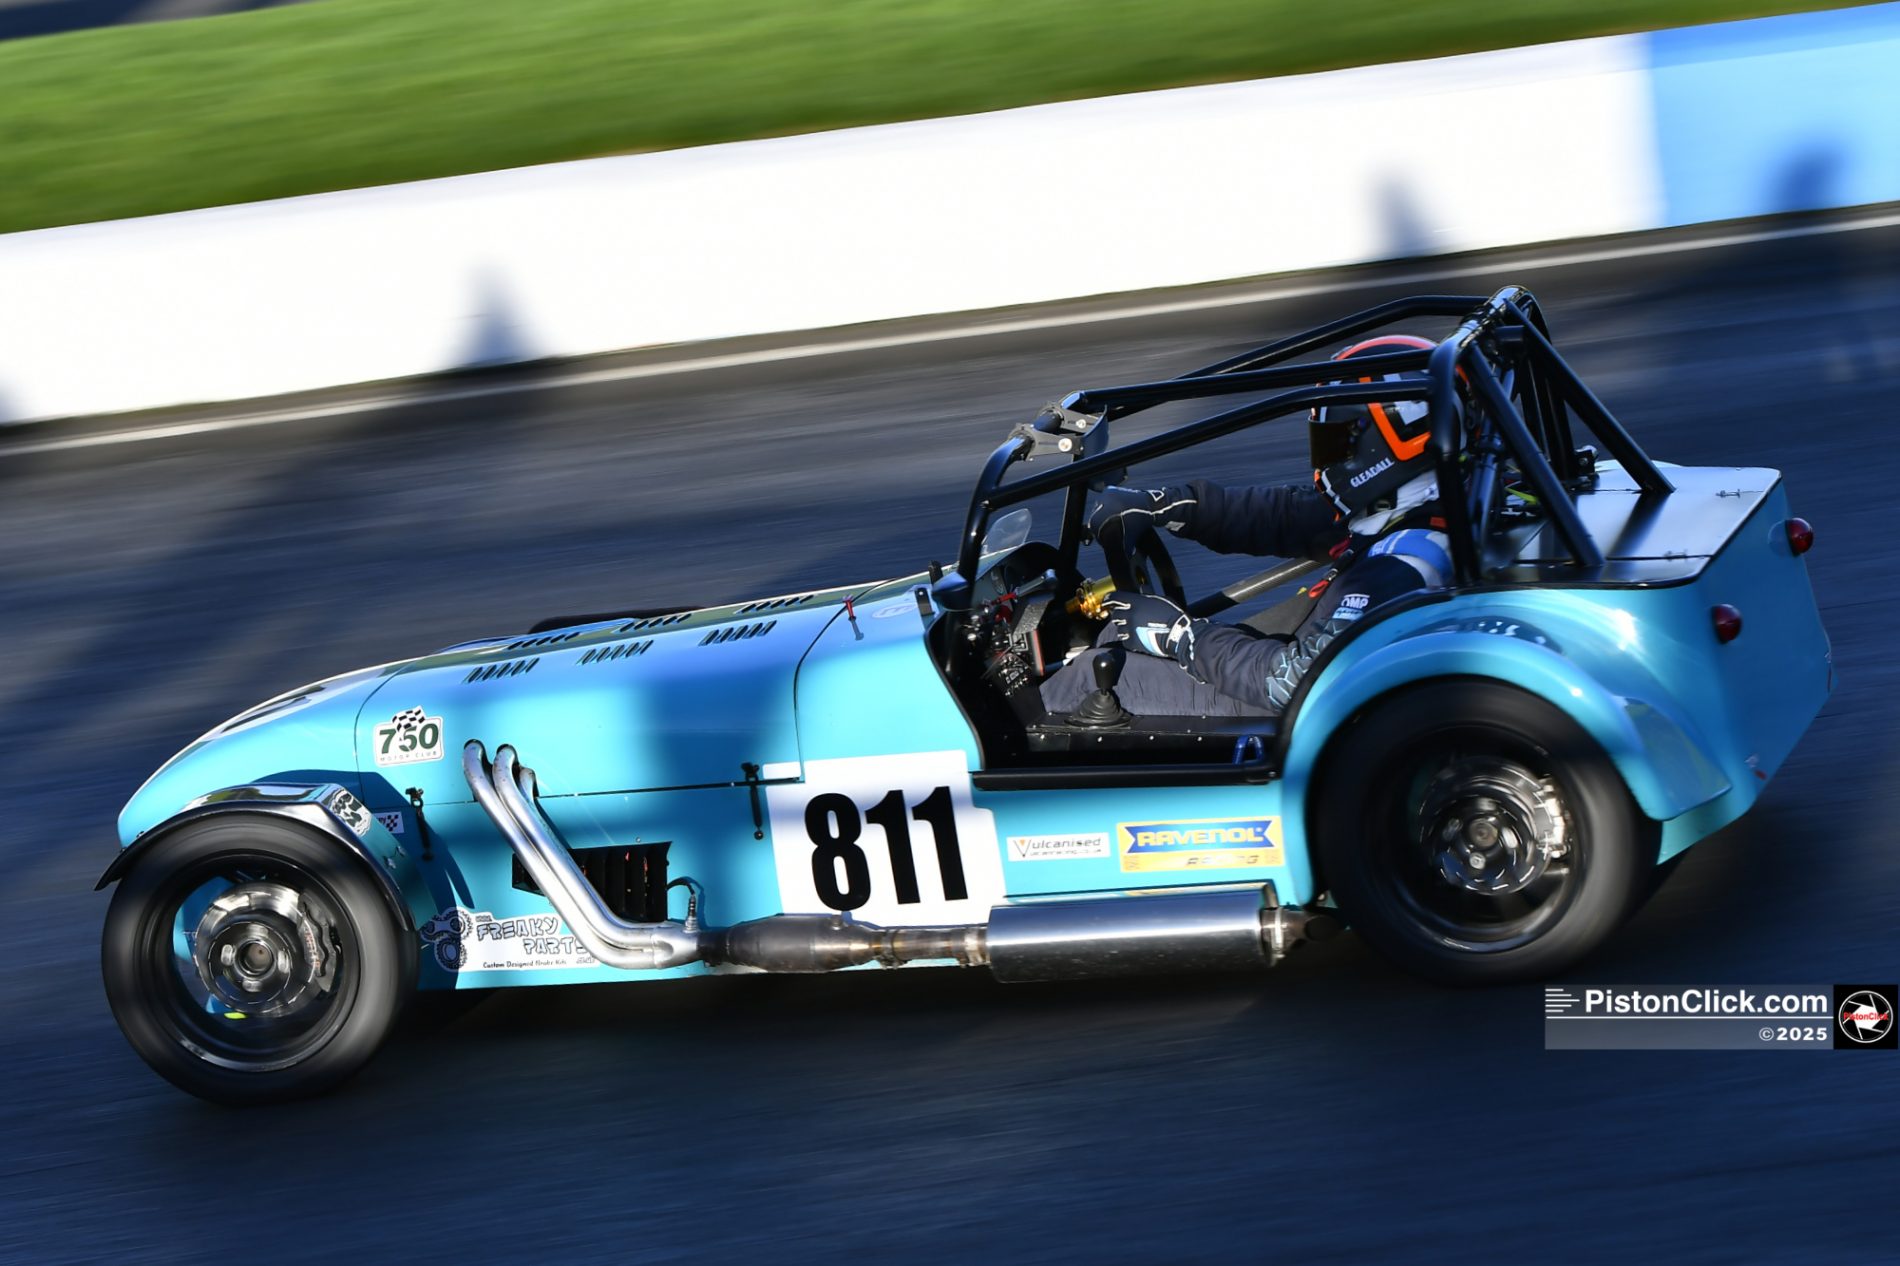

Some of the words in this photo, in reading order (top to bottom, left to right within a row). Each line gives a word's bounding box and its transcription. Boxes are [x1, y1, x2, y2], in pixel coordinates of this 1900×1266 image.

[1350, 457, 1395, 488] GLEADALL
[1340, 596, 1369, 609] OMP
[379, 723, 439, 755] 750
[1013, 837, 1102, 858] Vulcanised
[1136, 827, 1264, 847] RAVENOL
[804, 786, 969, 912] 811
[476, 916, 559, 941] FREAKY
[483, 961, 505, 969] Custom
[506, 959, 533, 968] Designed
